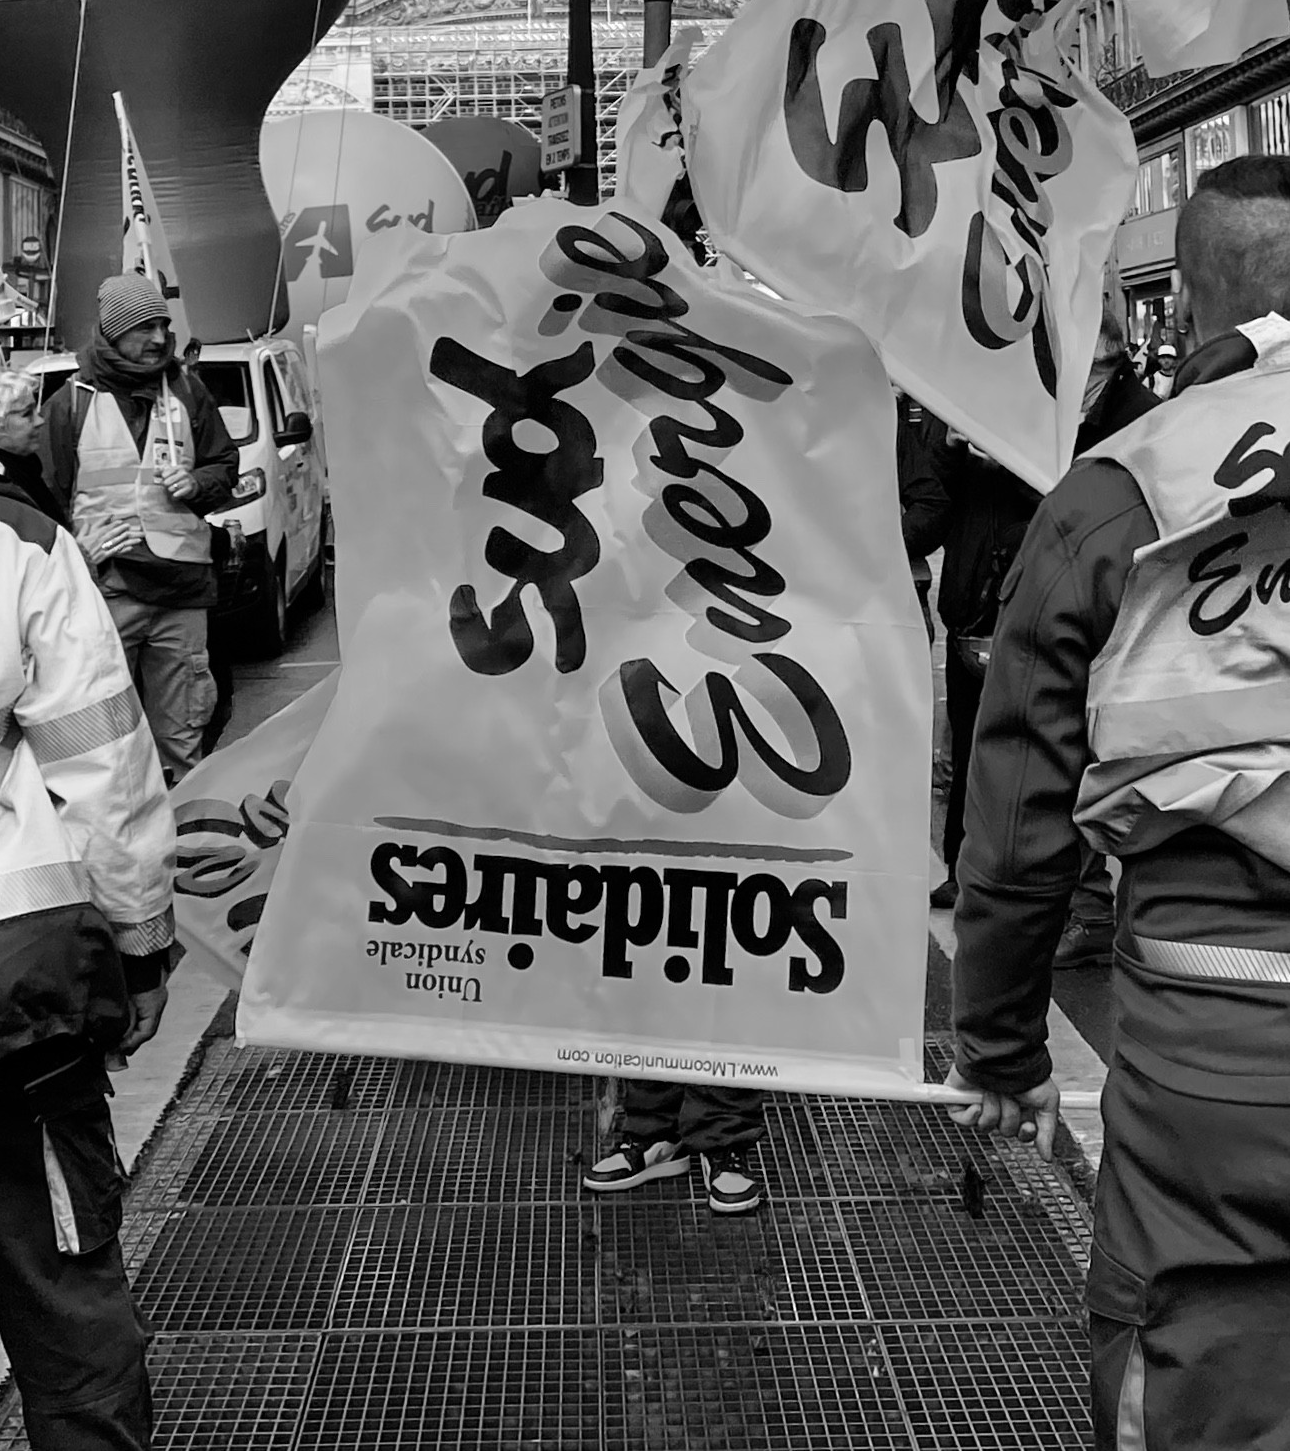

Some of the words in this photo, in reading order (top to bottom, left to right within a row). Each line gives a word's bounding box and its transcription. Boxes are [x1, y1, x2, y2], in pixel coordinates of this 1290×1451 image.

[429, 336, 604, 676] Sud
[539, 209, 852, 820] Energie
[366, 940, 487, 966] syndicale
[367, 842, 848, 995] Solidaires
[406, 971, 483, 1004] Union
[557, 1048, 779, 1080] www.LMcommunication.com
